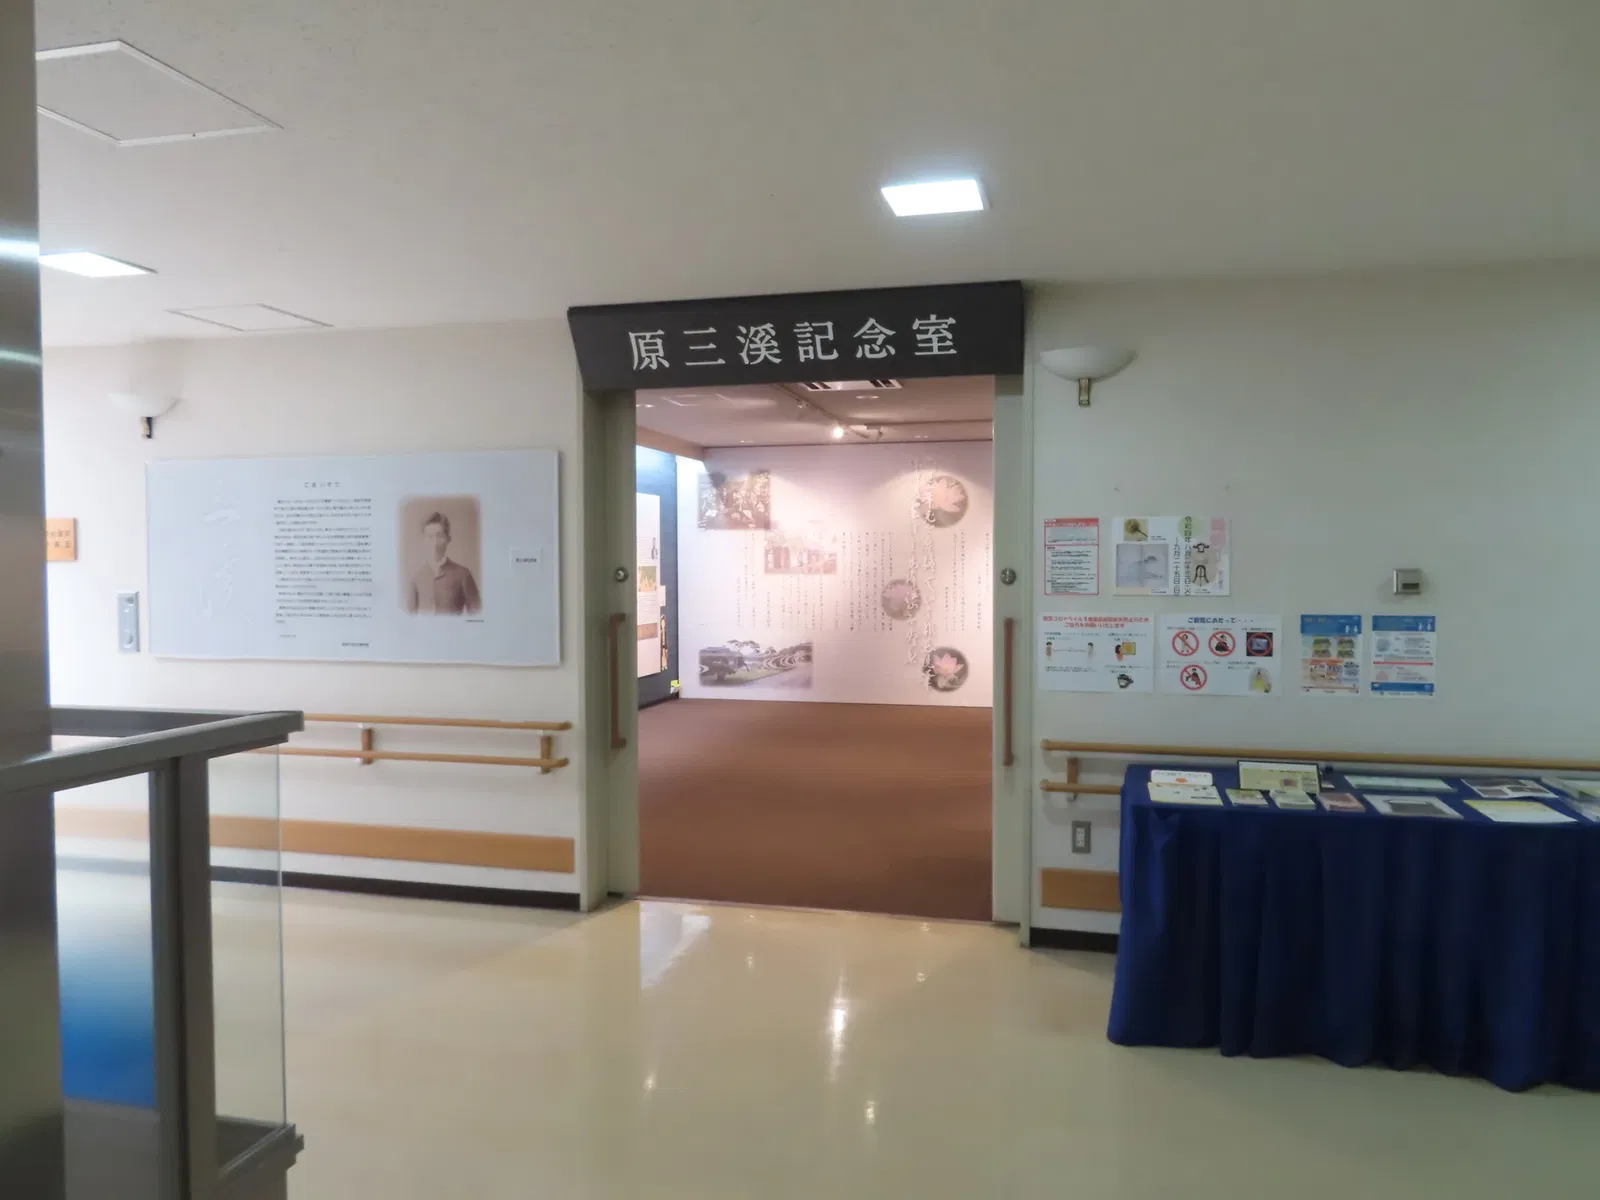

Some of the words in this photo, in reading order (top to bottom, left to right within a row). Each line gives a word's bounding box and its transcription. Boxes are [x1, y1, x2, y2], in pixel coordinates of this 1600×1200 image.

[628, 314, 957, 371] 原三溪記念室
